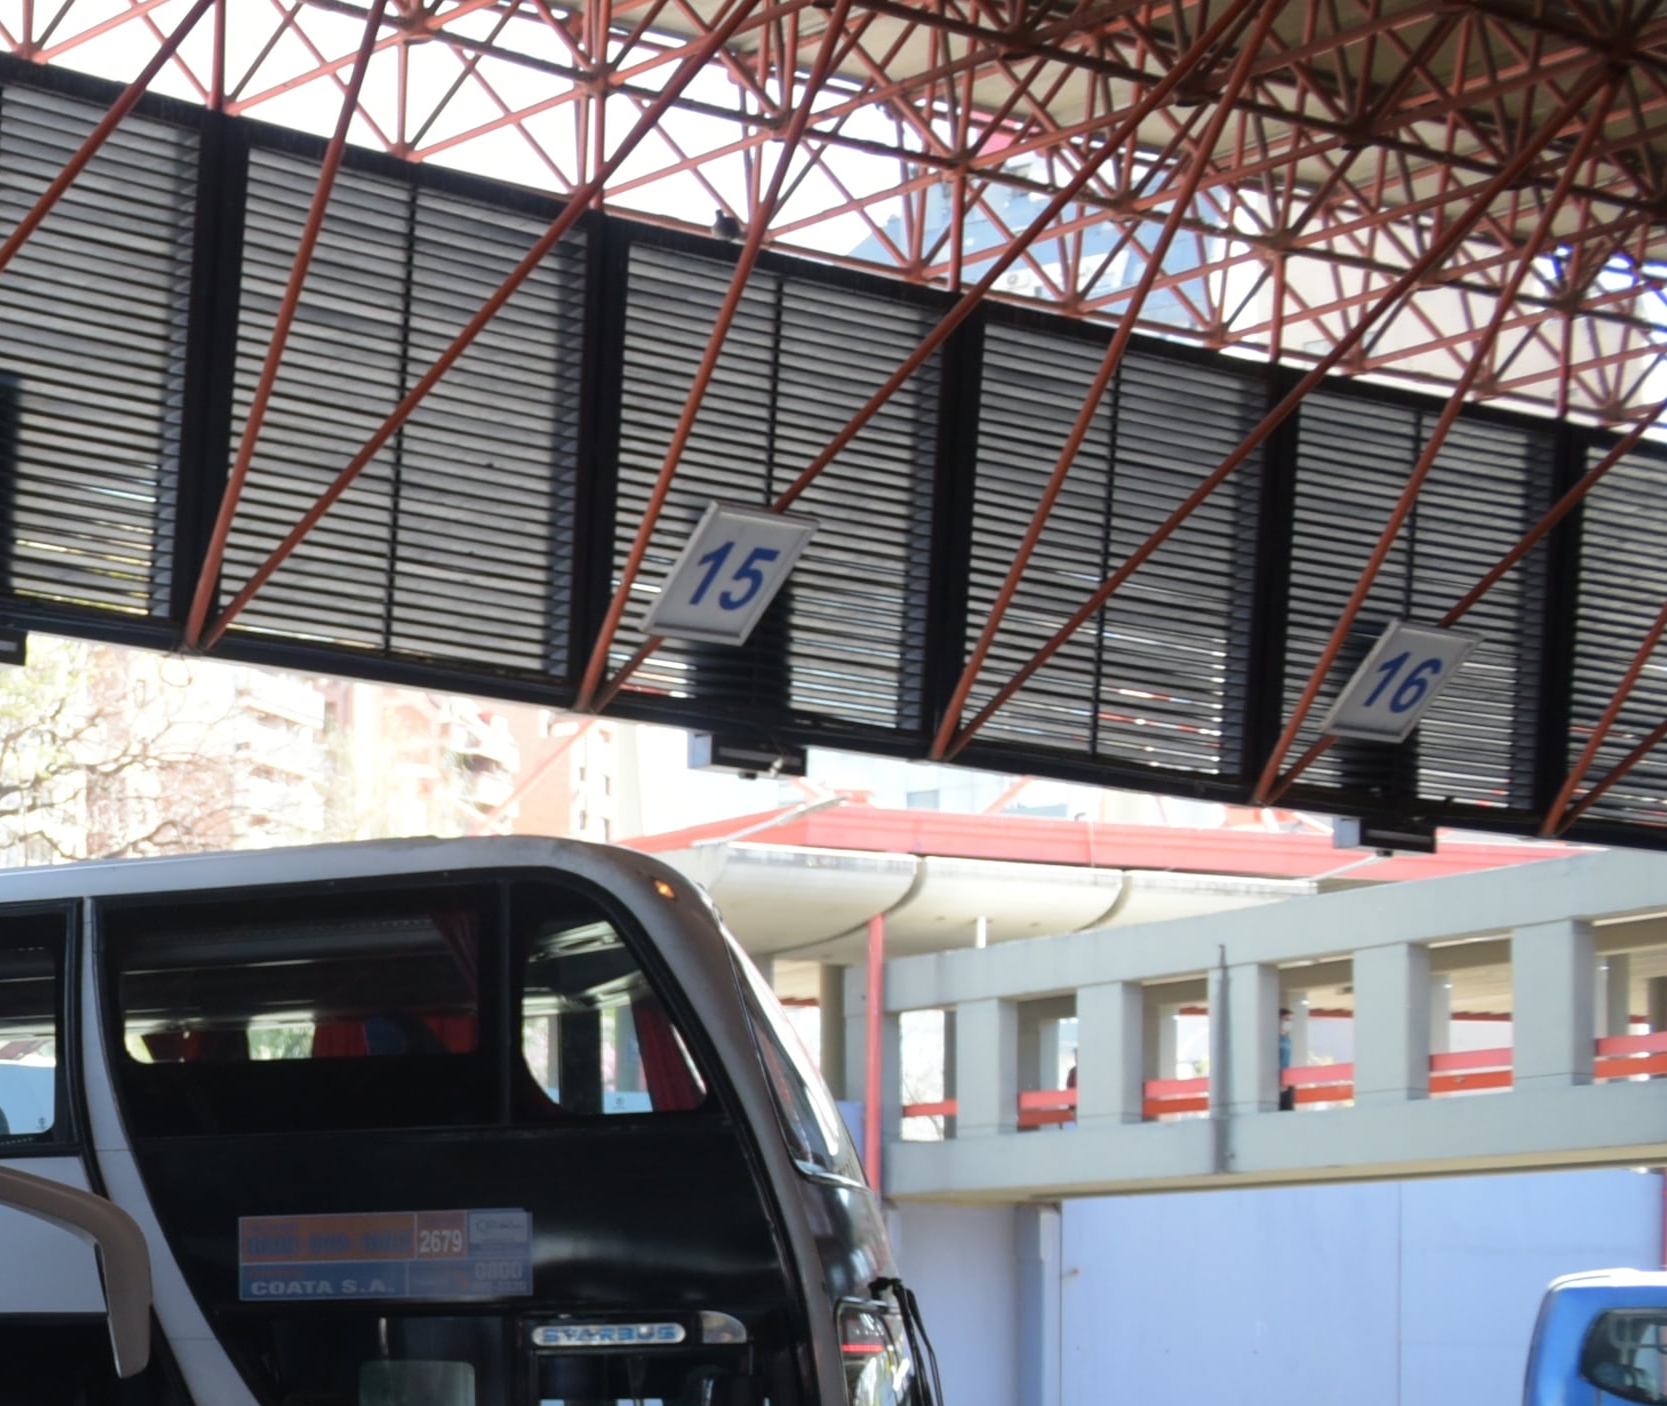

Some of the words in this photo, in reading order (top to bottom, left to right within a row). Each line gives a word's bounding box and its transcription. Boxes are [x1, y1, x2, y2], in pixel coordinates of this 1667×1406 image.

[688, 541, 780, 611] 15
[1363, 652, 1443, 714] 16
[419, 1229, 464, 1253] 2679
[250, 1280, 334, 1296] COATA
[341, 1278, 396, 1294] S.A.
